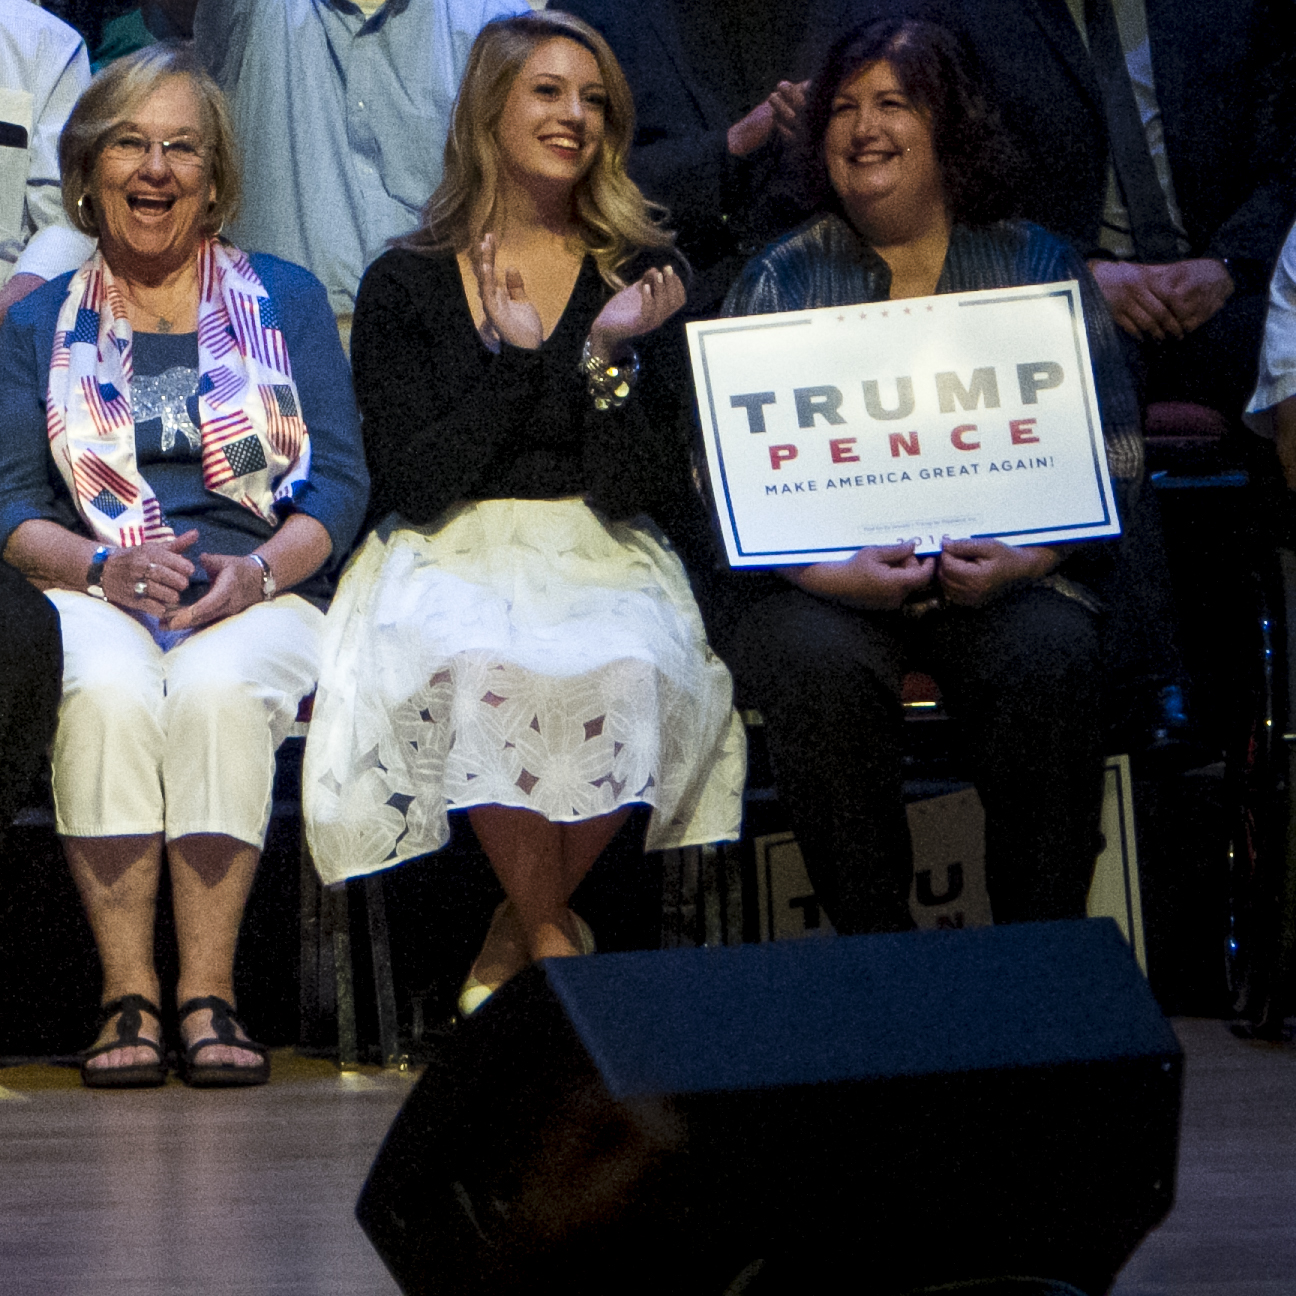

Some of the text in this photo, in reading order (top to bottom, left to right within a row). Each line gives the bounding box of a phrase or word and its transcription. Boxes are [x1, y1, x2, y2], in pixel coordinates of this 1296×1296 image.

[729, 360, 1065, 434] TRUMP
[767, 417, 1040, 471] PENCE
[765, 455, 1055, 496] MAKE AMERICA GREAT AGAIN!
